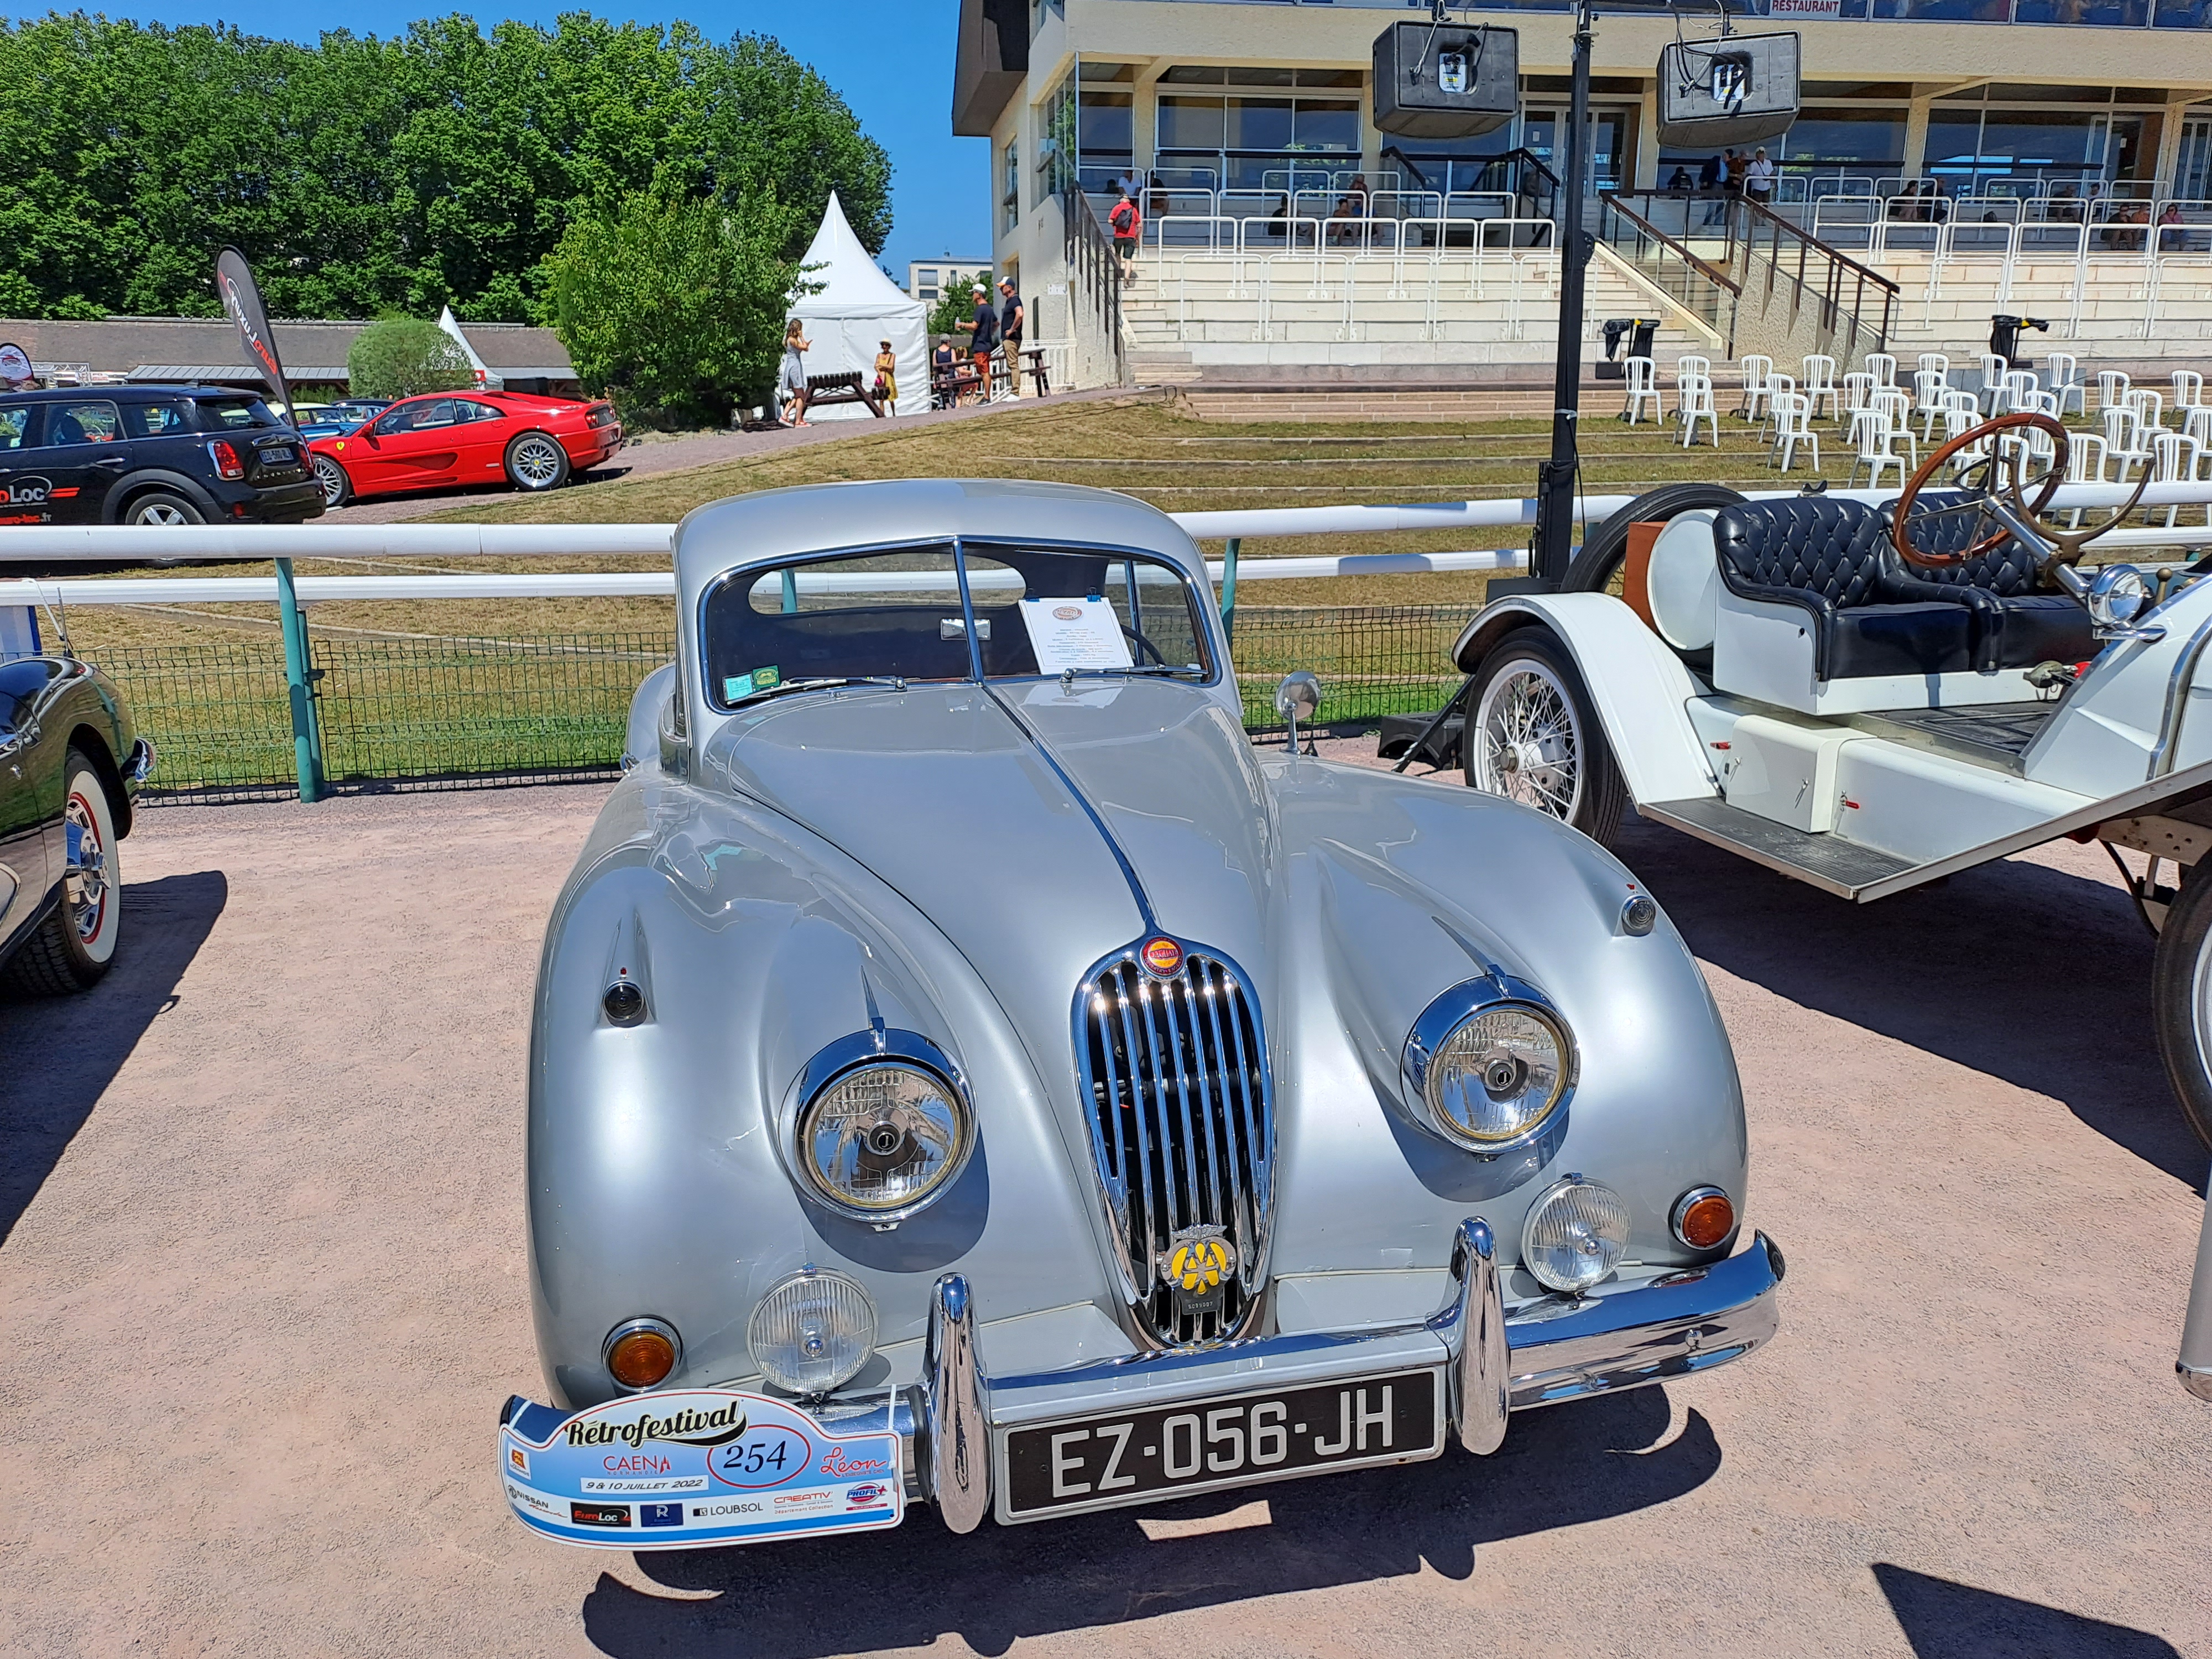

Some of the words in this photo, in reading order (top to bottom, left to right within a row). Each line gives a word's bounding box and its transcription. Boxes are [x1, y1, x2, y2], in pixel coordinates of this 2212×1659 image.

[1772, 0, 1839, 13] RESTAURANT
[1500, 1072, 1507, 1084] J
[881, 1135, 890, 1148] J
[565, 1400, 747, 1448] Rétrofestival
[603, 1454, 658, 1472] CAEN
[723, 1440, 787, 1473] 254
[820, 1446, 887, 1478] Léon
[623, 1481, 669, 1490] JUILLET
[671, 1479, 703, 1488] 2022
[517, 1490, 549, 1509] NISSAN
[711, 1502, 763, 1515] LOUBSOL
[575, 1510, 618, 1521] EuroLoc
